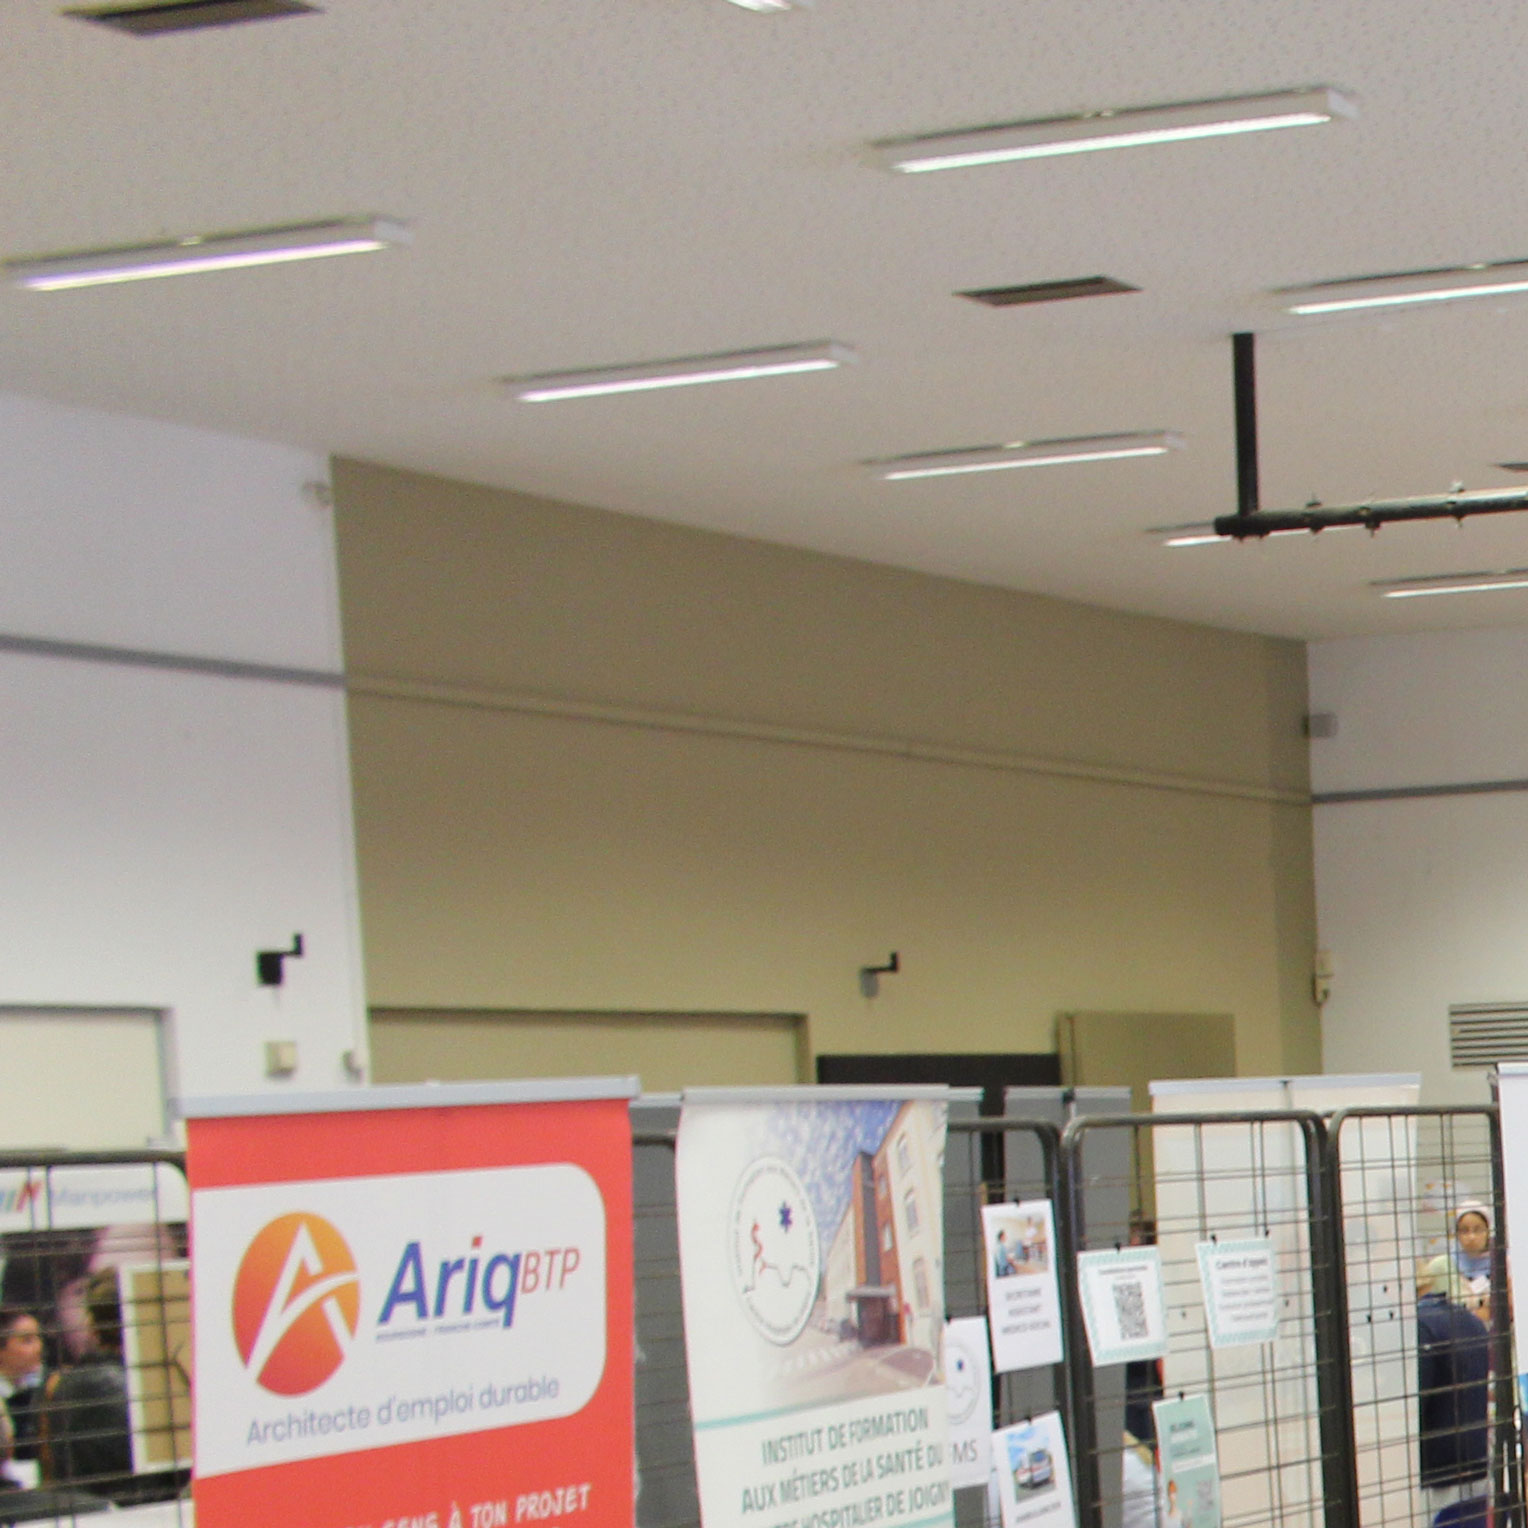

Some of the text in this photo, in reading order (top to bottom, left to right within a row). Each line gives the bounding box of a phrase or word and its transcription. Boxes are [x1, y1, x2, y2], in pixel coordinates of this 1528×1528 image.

[246, 1376, 560, 1447] Architecte d'emploi durable
[761, 1406, 929, 1466] INSTITUT DE FORMATION
[515, 1482, 592, 1520] PROJET
[741, 1485, 778, 1515] AUX
[780, 1468, 840, 1502] MÉTIERS
[842, 1462, 859, 1488] DE
[860, 1460, 876, 1484] LA
[876, 1440, 923, 1480] SANTÉ
[885, 1489, 904, 1518] DE
